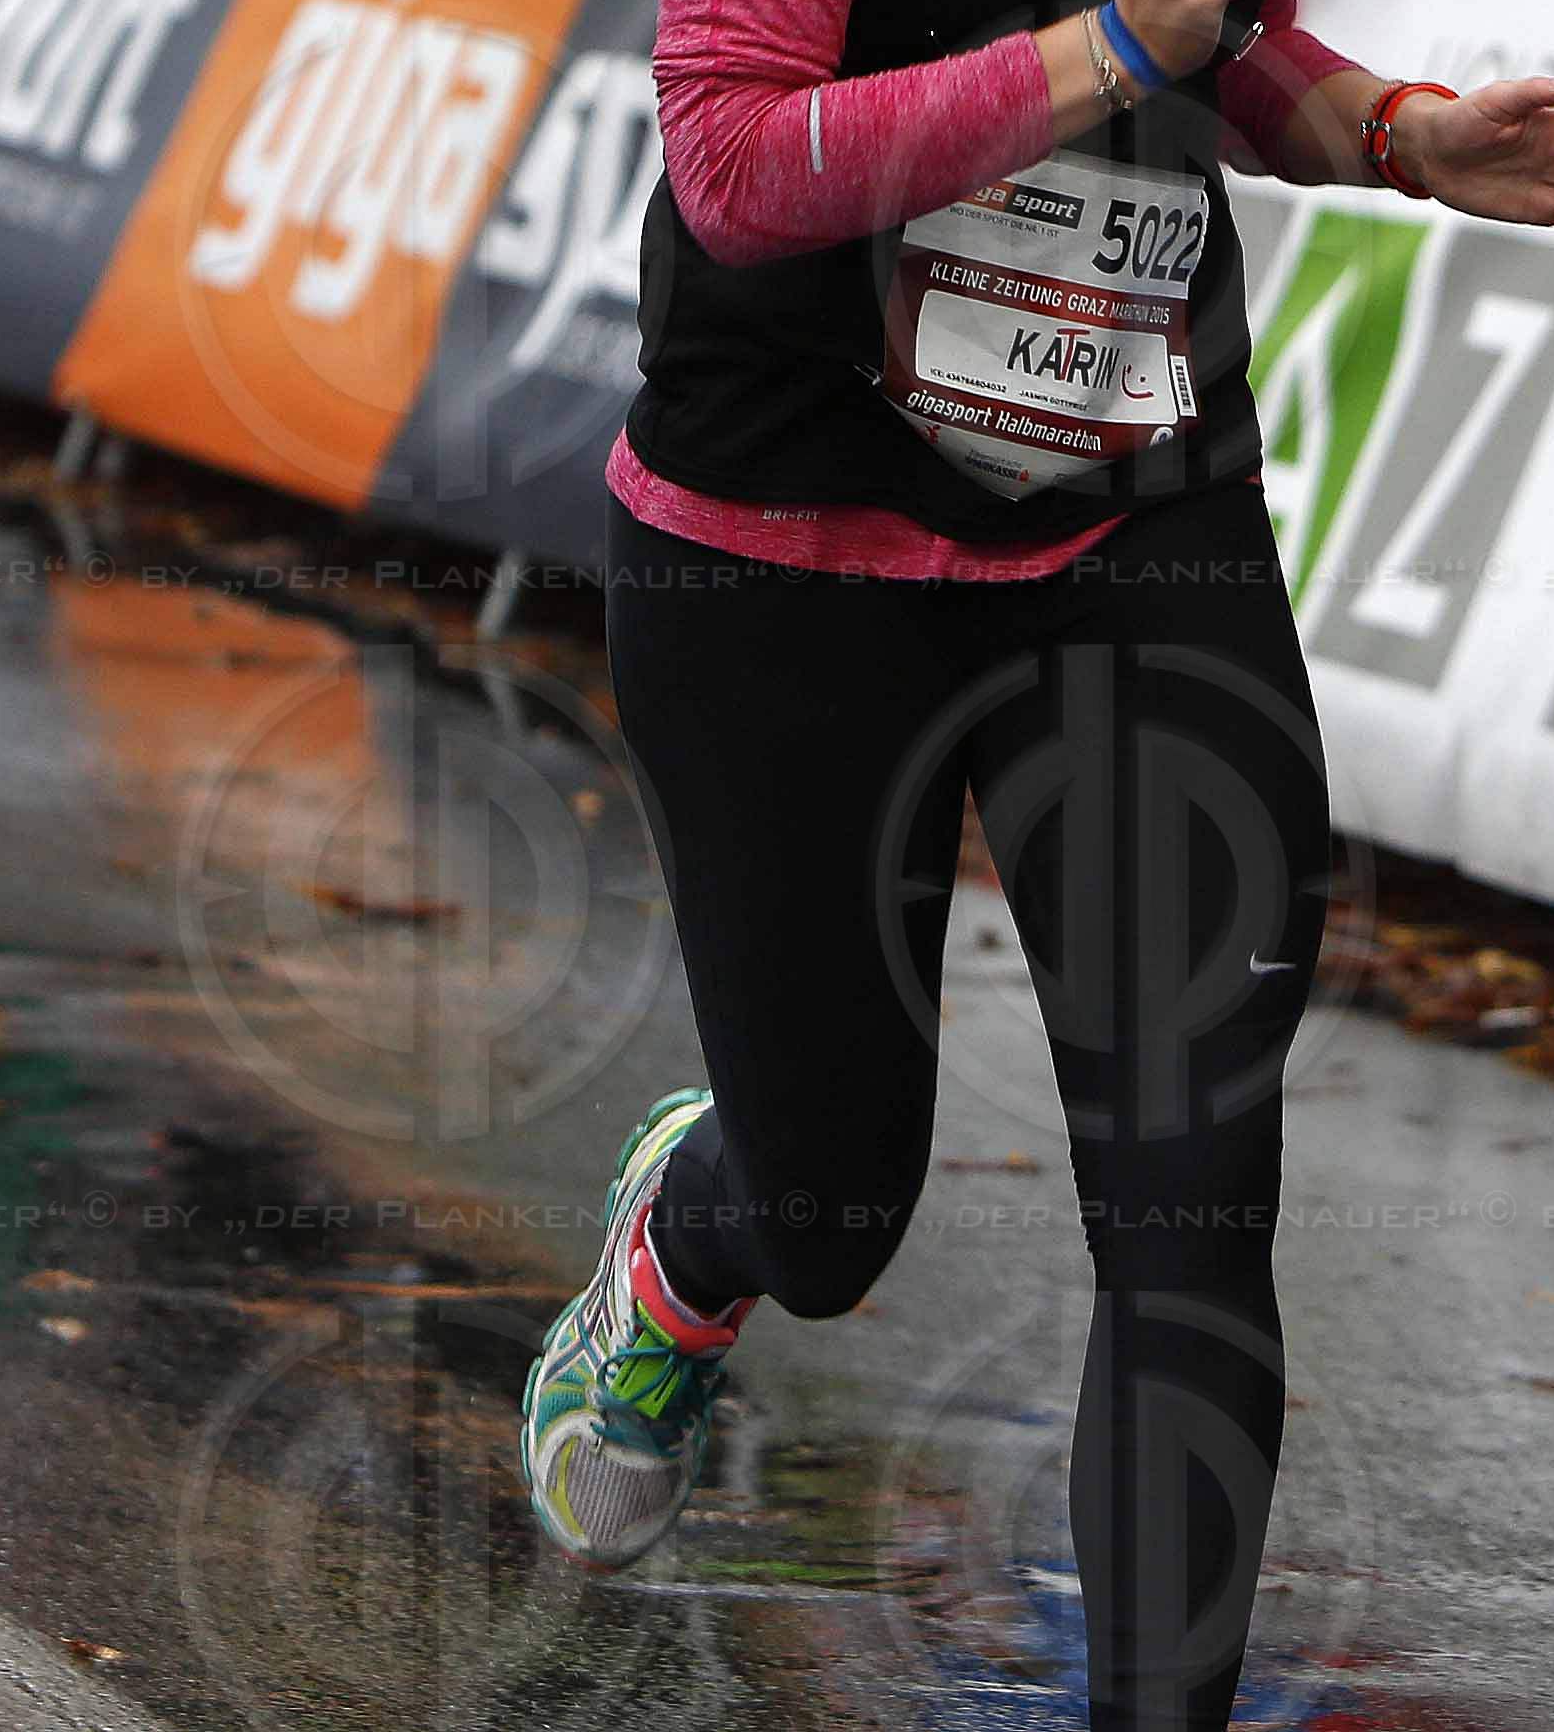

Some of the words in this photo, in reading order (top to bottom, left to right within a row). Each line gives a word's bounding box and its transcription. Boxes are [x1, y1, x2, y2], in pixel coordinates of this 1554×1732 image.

[973, 184, 1008, 204] ga
[1012, 192, 1079, 221] sport
[1091, 199, 1203, 280] 5022
[930, 262, 990, 291] KLEINE
[992, 276, 1062, 315] ZEITUNG
[1068, 293, 1106, 318] GRAZ
[1149, 304, 1170, 325] 2015
[906, 389, 992, 427] gigasport
[995, 412, 1102, 451] Halbmarathon
